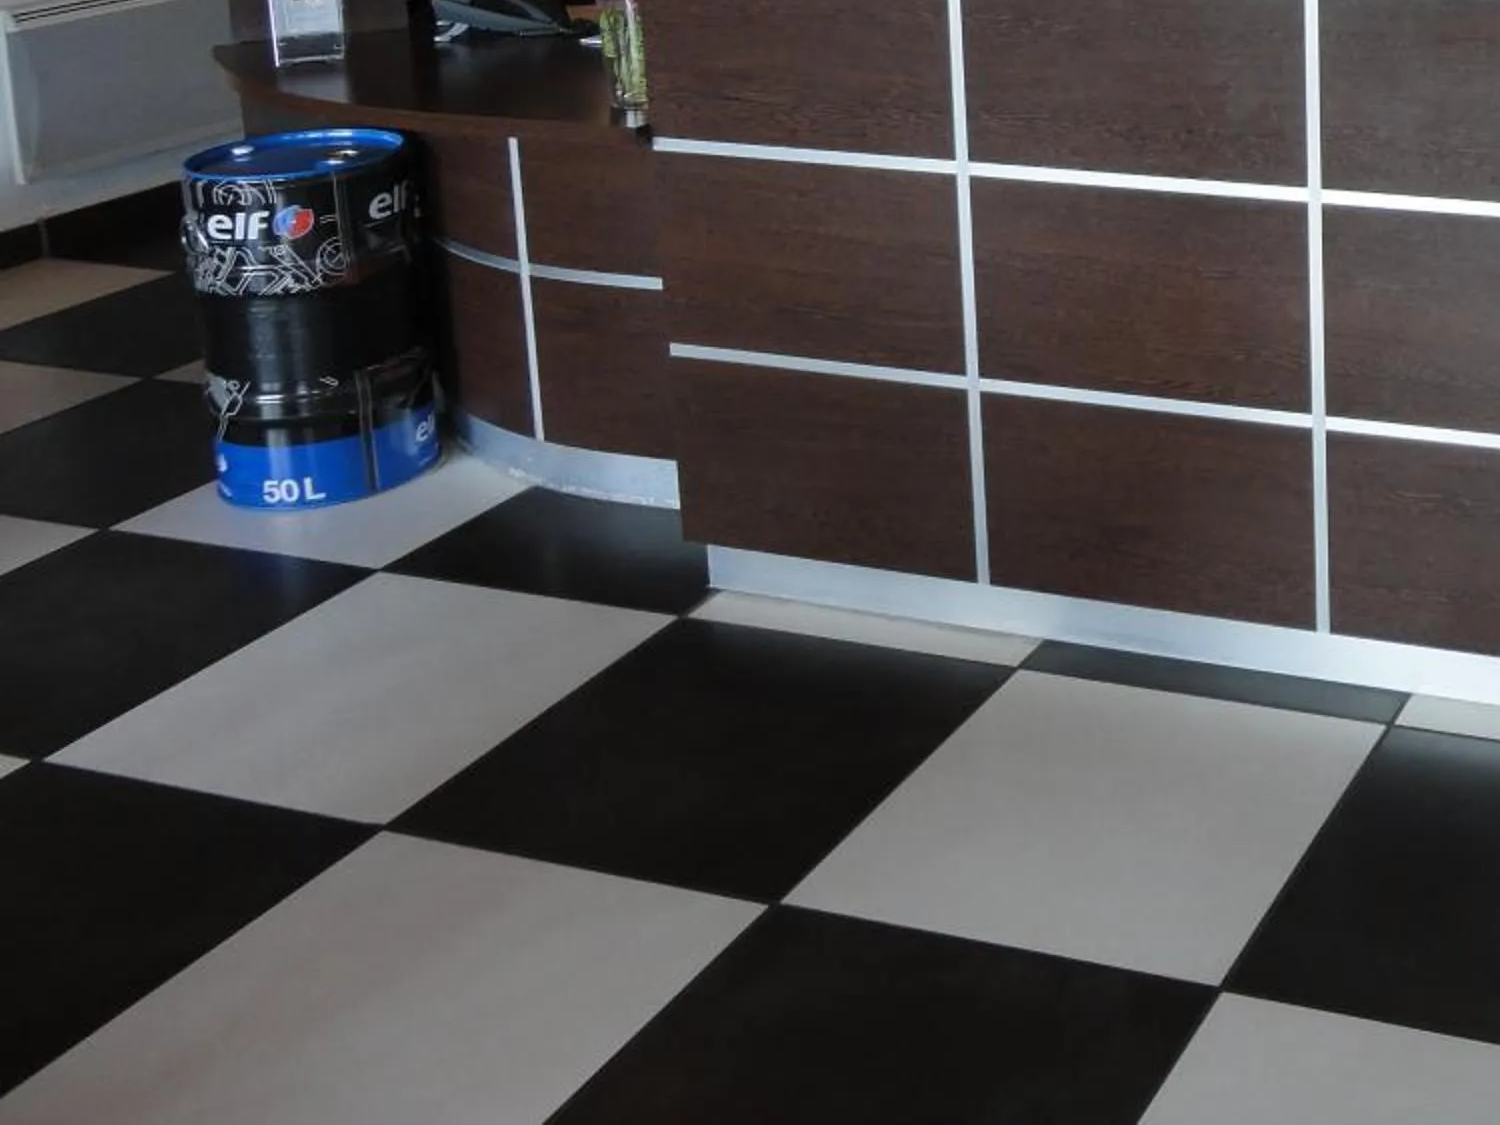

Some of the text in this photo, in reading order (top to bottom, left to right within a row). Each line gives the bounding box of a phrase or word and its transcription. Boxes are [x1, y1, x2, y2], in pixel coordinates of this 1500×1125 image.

[369, 179, 409, 220] elf
[207, 209, 271, 241] elf
[262, 476, 326, 504] 50 L
